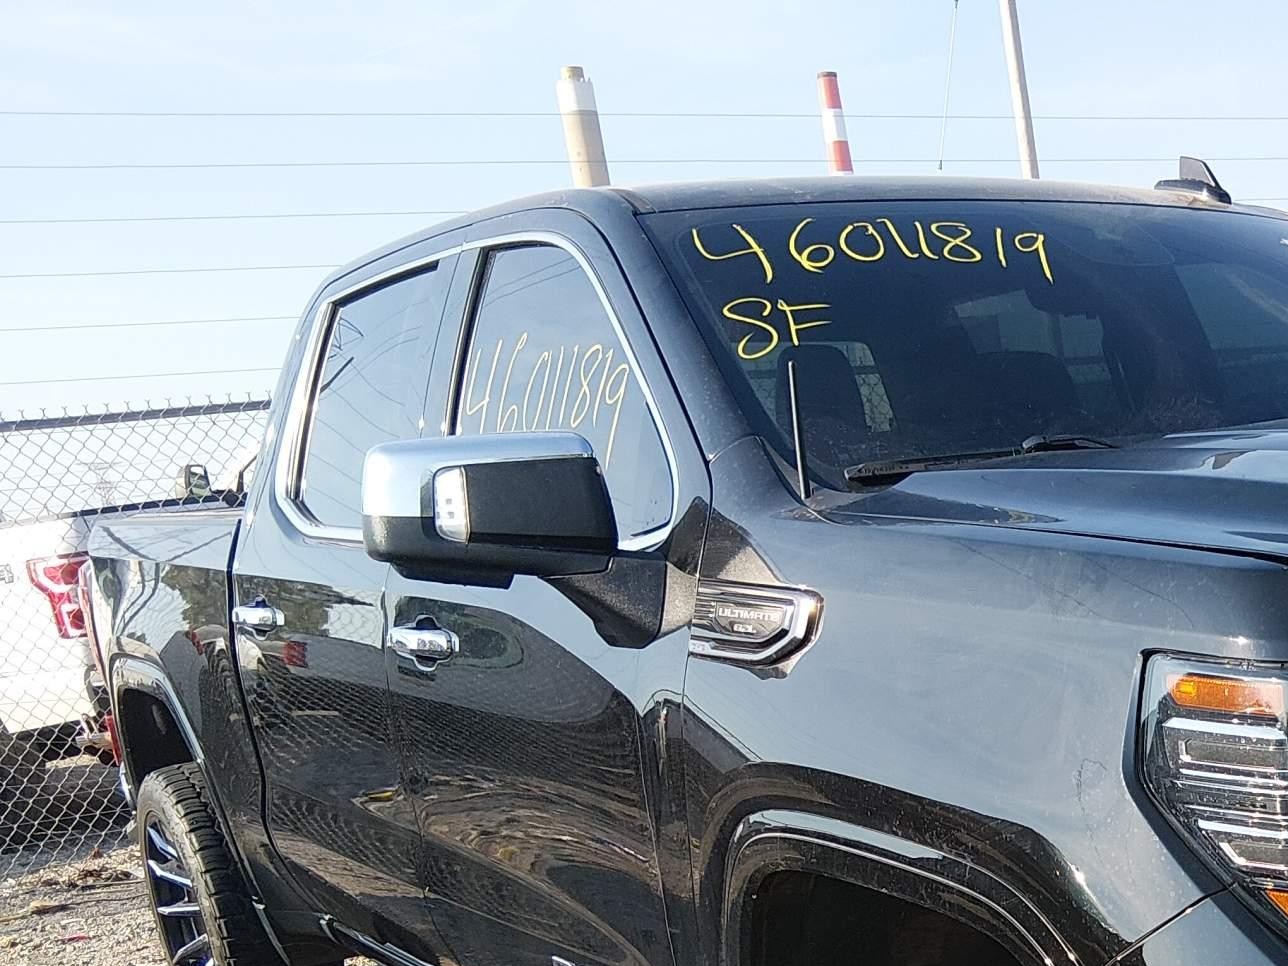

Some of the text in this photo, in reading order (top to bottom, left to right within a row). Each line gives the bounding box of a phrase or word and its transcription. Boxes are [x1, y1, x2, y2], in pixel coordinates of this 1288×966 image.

[692, 217, 1053, 284] 46011819
[722, 297, 832, 360] SF
[465, 331, 629, 471] 46011819
[718, 607, 782, 623] ULTIMATE
